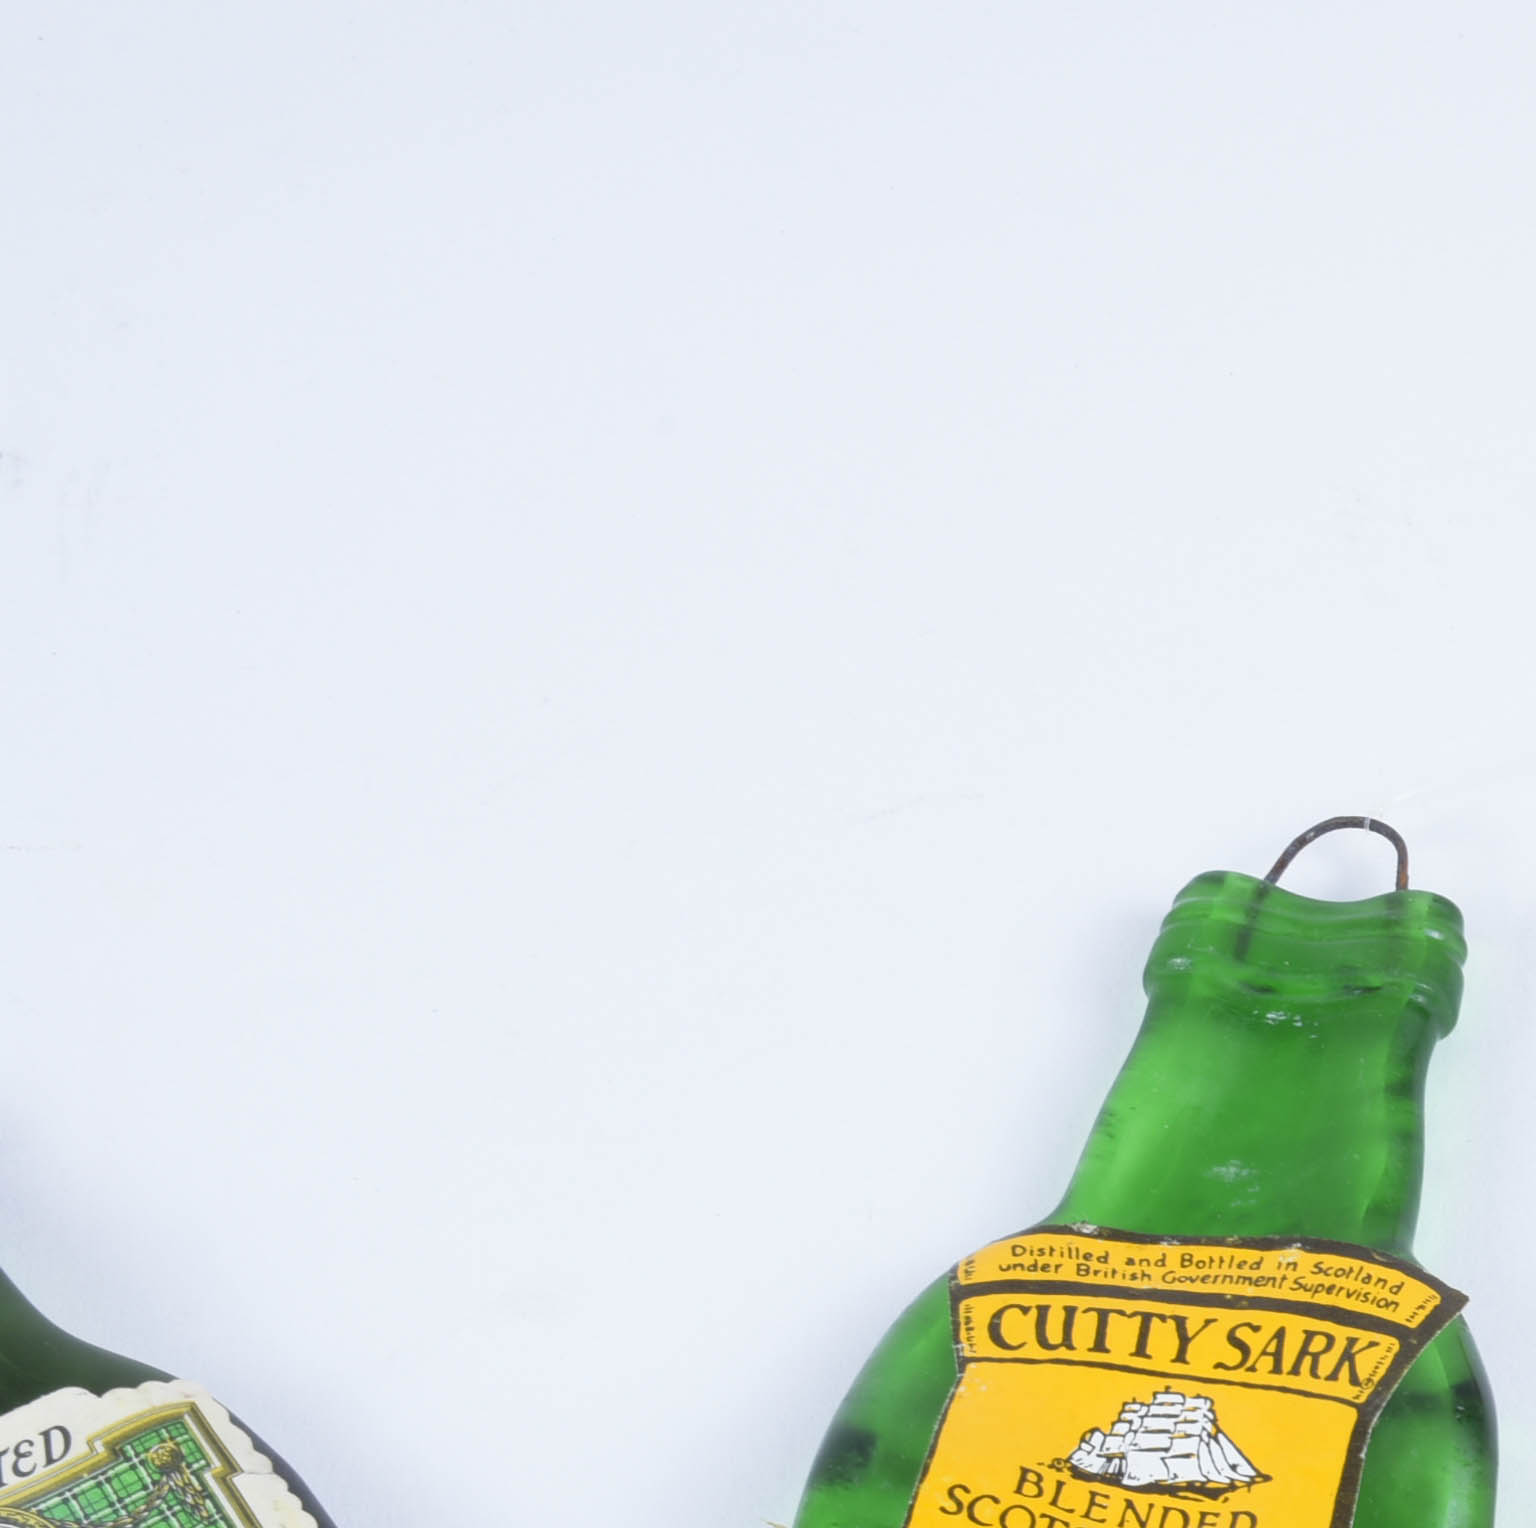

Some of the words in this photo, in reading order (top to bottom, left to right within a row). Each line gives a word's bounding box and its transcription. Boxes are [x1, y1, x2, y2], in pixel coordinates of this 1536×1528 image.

[998, 1258, 1063, 1275] under
[1075, 1261, 1152, 1282] British
[1161, 1270, 1289, 1290] Government
[1289, 1276, 1400, 1313] Supervision
[1010, 1244, 1110, 1266] Distilled
[1124, 1252, 1167, 1268] and
[1179, 1252, 1264, 1271] Bottled
[1276, 1261, 1299, 1273] in
[1311, 1260, 1405, 1296] Scotland
[987, 1303, 1218, 1365] CUTTY
[1212, 1321, 1381, 1390] SARK
